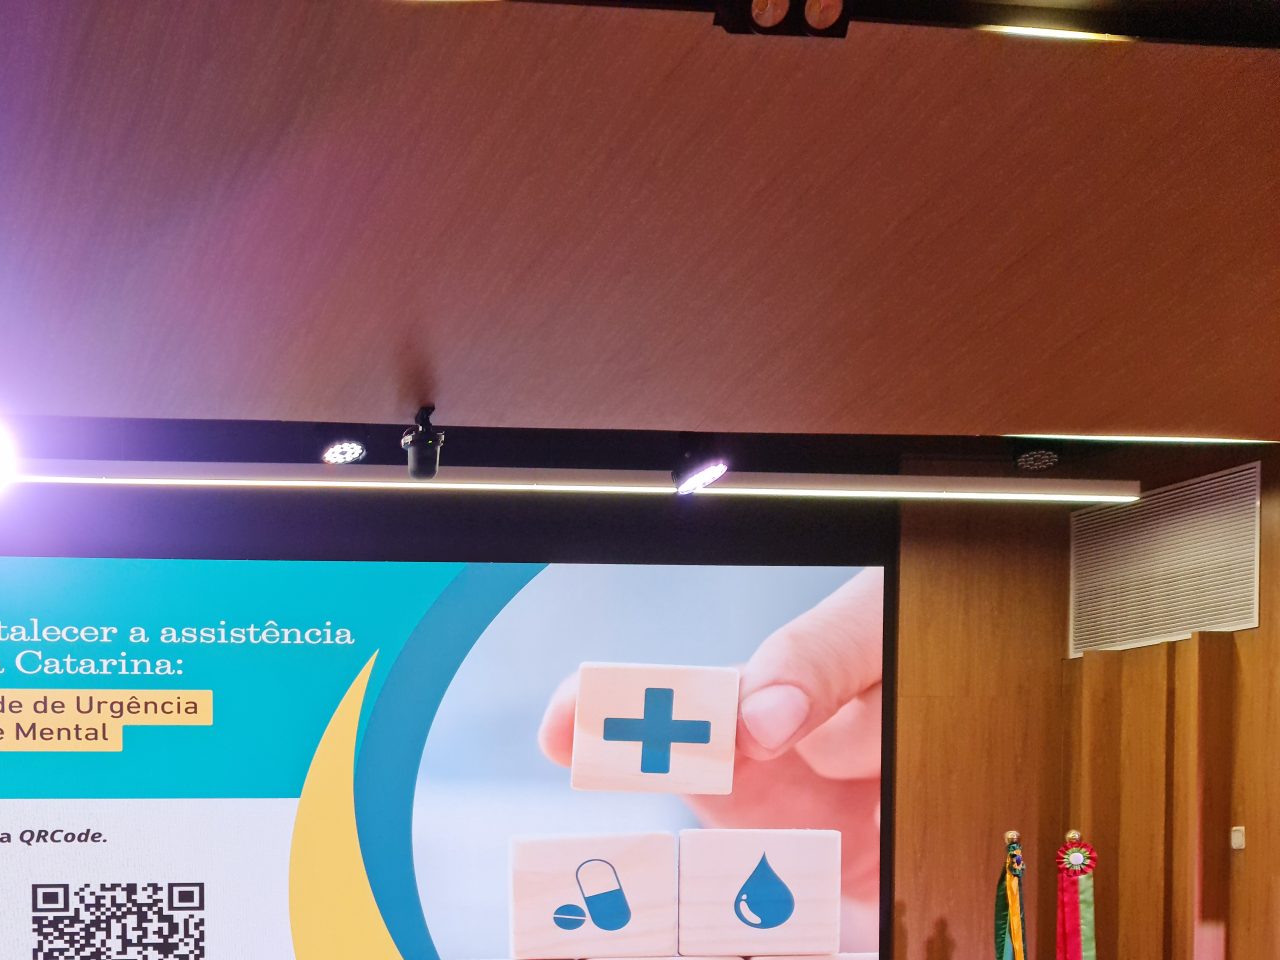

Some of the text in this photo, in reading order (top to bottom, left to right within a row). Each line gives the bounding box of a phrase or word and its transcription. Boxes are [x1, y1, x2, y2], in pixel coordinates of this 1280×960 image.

[129, 627, 149, 643] a
[160, 620, 355, 644] assistência
[15, 650, 183, 675] Catarina:
[33, 696, 65, 714] de
[76, 696, 198, 718] Urgência
[15, 723, 108, 741] Mental
[20, 829, 108, 846] QRCode.
